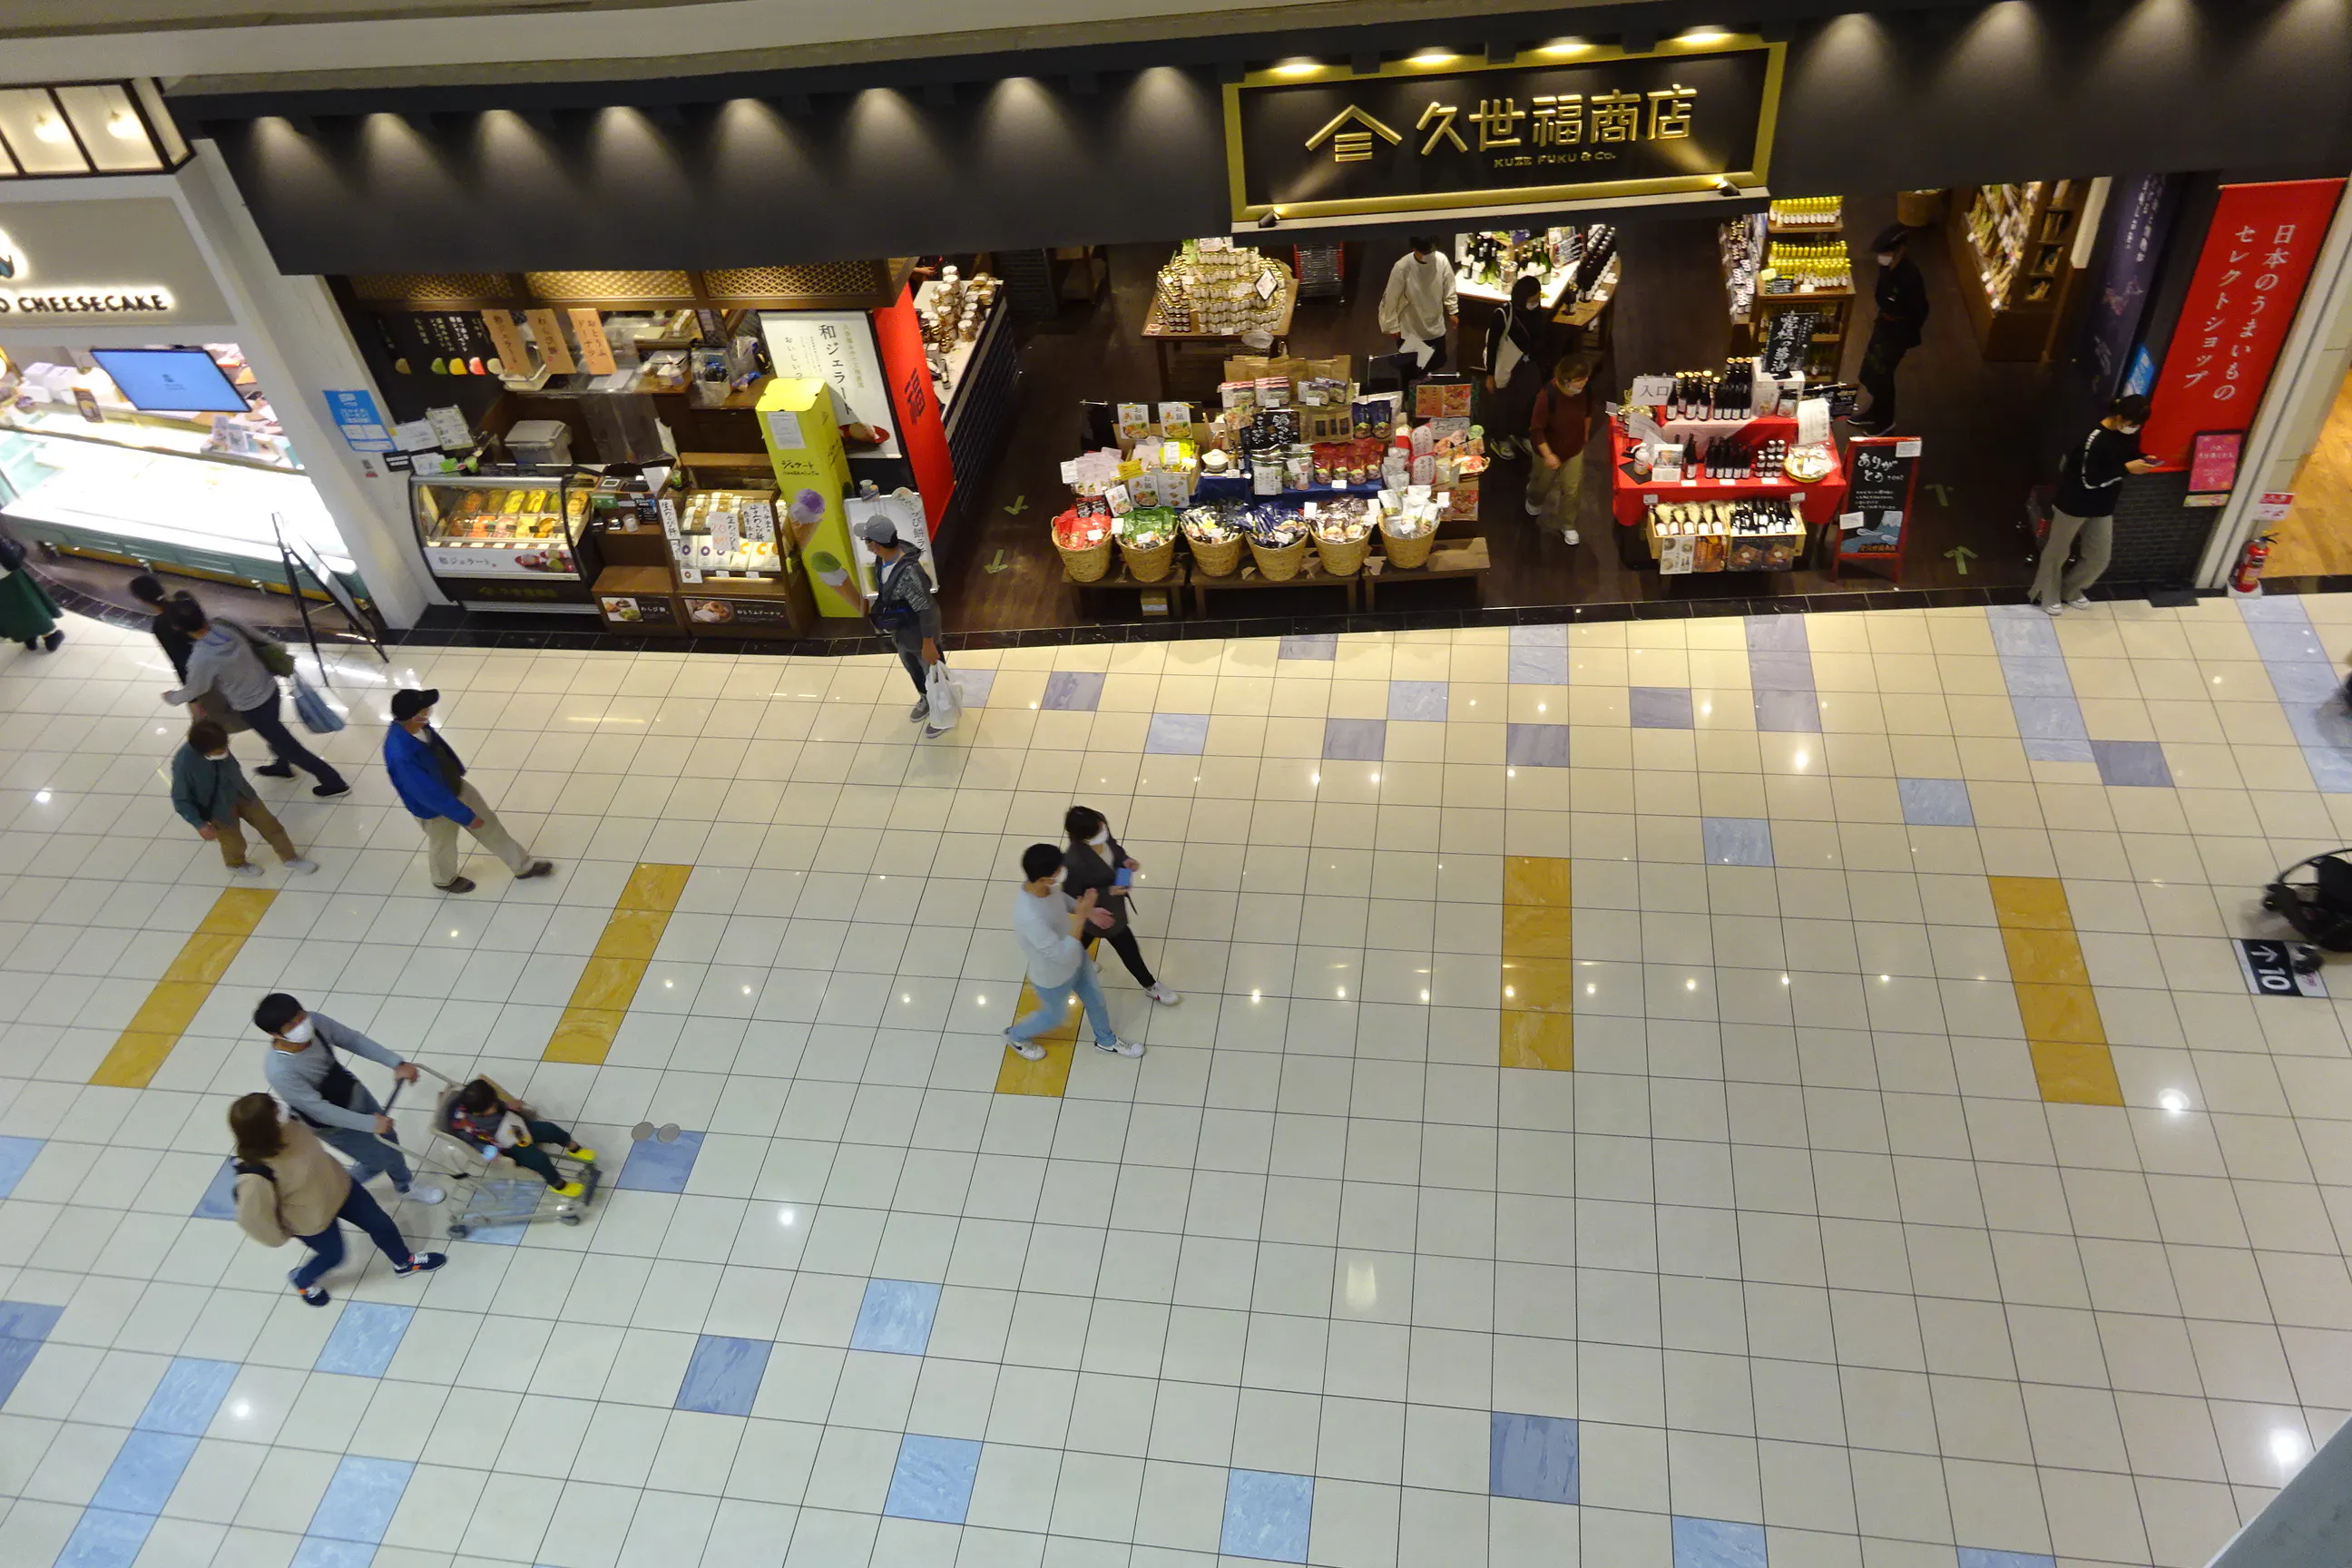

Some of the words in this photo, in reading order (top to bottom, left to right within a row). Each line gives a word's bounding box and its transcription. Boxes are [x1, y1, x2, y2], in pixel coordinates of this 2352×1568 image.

[1416, 83, 1697, 156] 久世福商店
[1494, 155, 1533, 168] KUZE
[1537, 153, 1577, 166] FUKU
[1581, 152, 1592, 162] &
[17, 295, 168, 313] CHEESECAKE
[2182, 225, 2257, 389] セレクトショップ
[2213, 224, 2297, 401] 日本のうまいもの
[818, 324, 852, 416] 和ジェラート
[1640, 385, 1670, 397] 入口
[2258, 967, 2291, 991] 10
